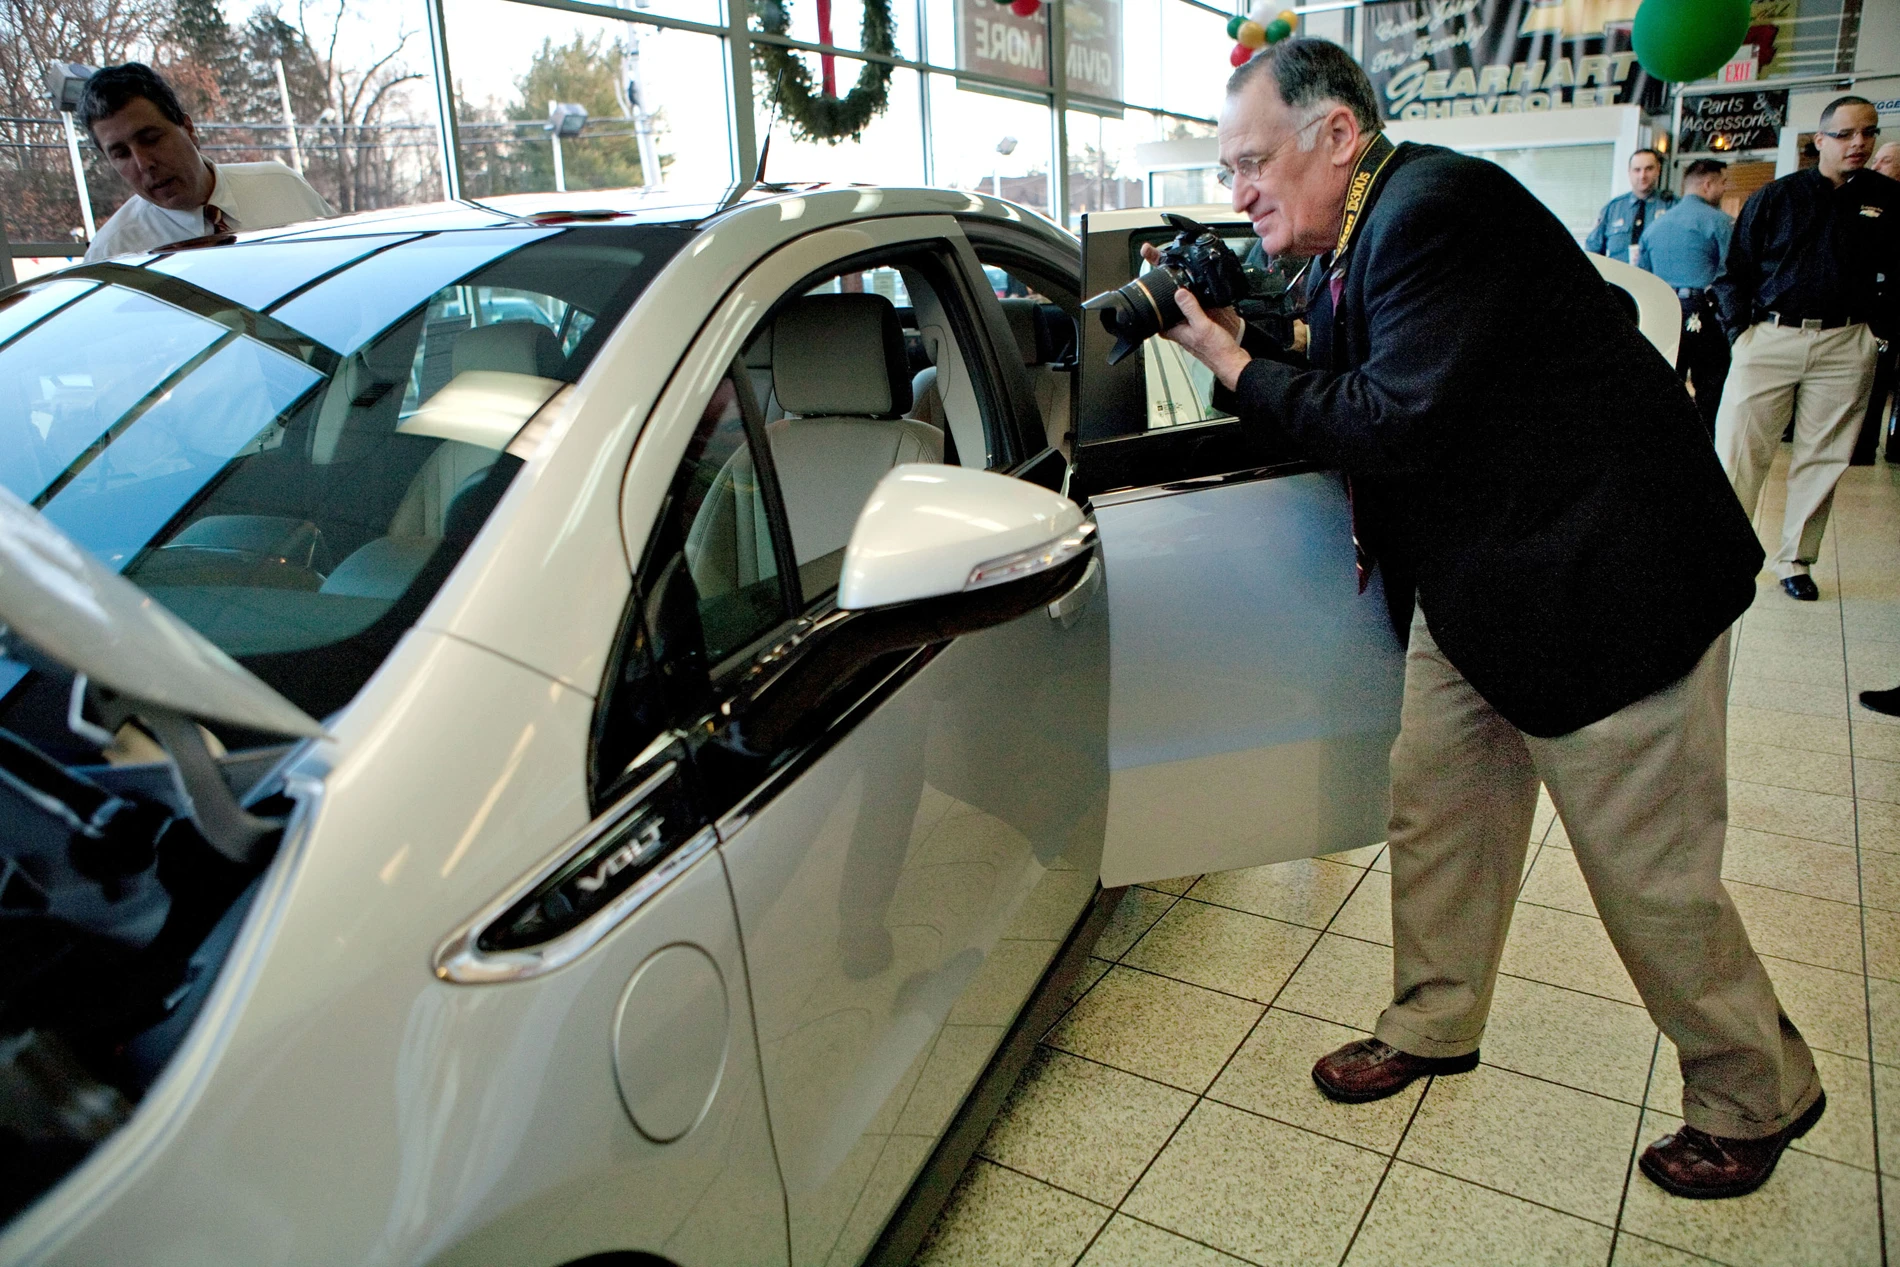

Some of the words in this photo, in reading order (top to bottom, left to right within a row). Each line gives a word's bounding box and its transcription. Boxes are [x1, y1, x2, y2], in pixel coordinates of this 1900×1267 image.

[1386, 51, 1639, 115] GEARHART
[1725, 61, 1752, 82] EXIT
[1400, 86, 1623, 121] CHEVROLET
[1697, 97, 1744, 115] Parts
[1753, 93, 1768, 111] &
[1346, 171, 1371, 212] D300s
[576, 816, 665, 892] VOLT
